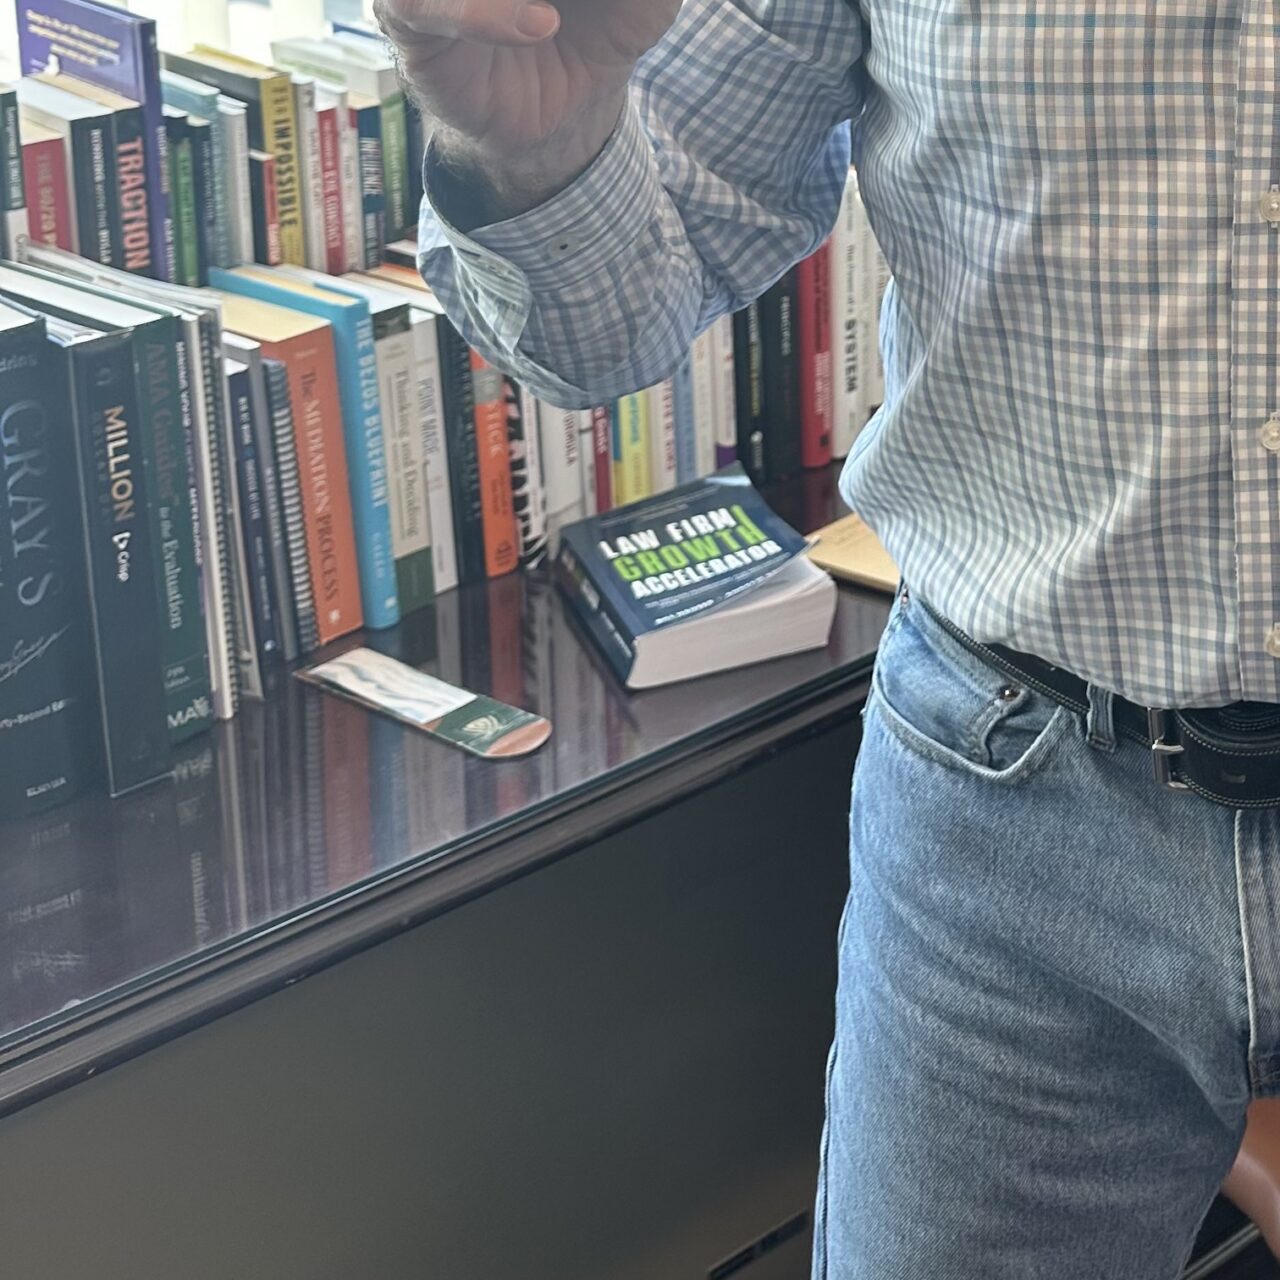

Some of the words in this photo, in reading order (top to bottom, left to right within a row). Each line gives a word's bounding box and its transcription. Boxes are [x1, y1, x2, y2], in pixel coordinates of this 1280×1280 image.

[91, 129, 106, 182] RUNNING
[274, 118, 299, 228] IMPOSSIBLE
[359, 136, 383, 197] INFLUENCE
[116, 138, 152, 270] TRACTION
[358, 354, 380, 411] BEZOS
[845, 319, 858, 394] SYSTEM
[393, 368, 415, 438] Thinking
[417, 377, 437, 418] POINT
[104, 405, 137, 522] MILLION
[302, 398, 333, 515] MEDIATION
[363, 414, 389, 508] BLUEPRINT
[400, 440, 415, 469] and
[563, 410, 578, 467] ORMULA
[401, 470, 423, 537] Deciding
[599, 528, 661, 560] LAW
[665, 507, 738, 542] FIRM
[116, 550, 132, 583] Crisp
[315, 515, 341, 603] PROCESS
[611, 504, 769, 581] GROWTH
[629, 540, 783, 600] ACCELERATOR
[162, 538, 185, 630] Evaluation
